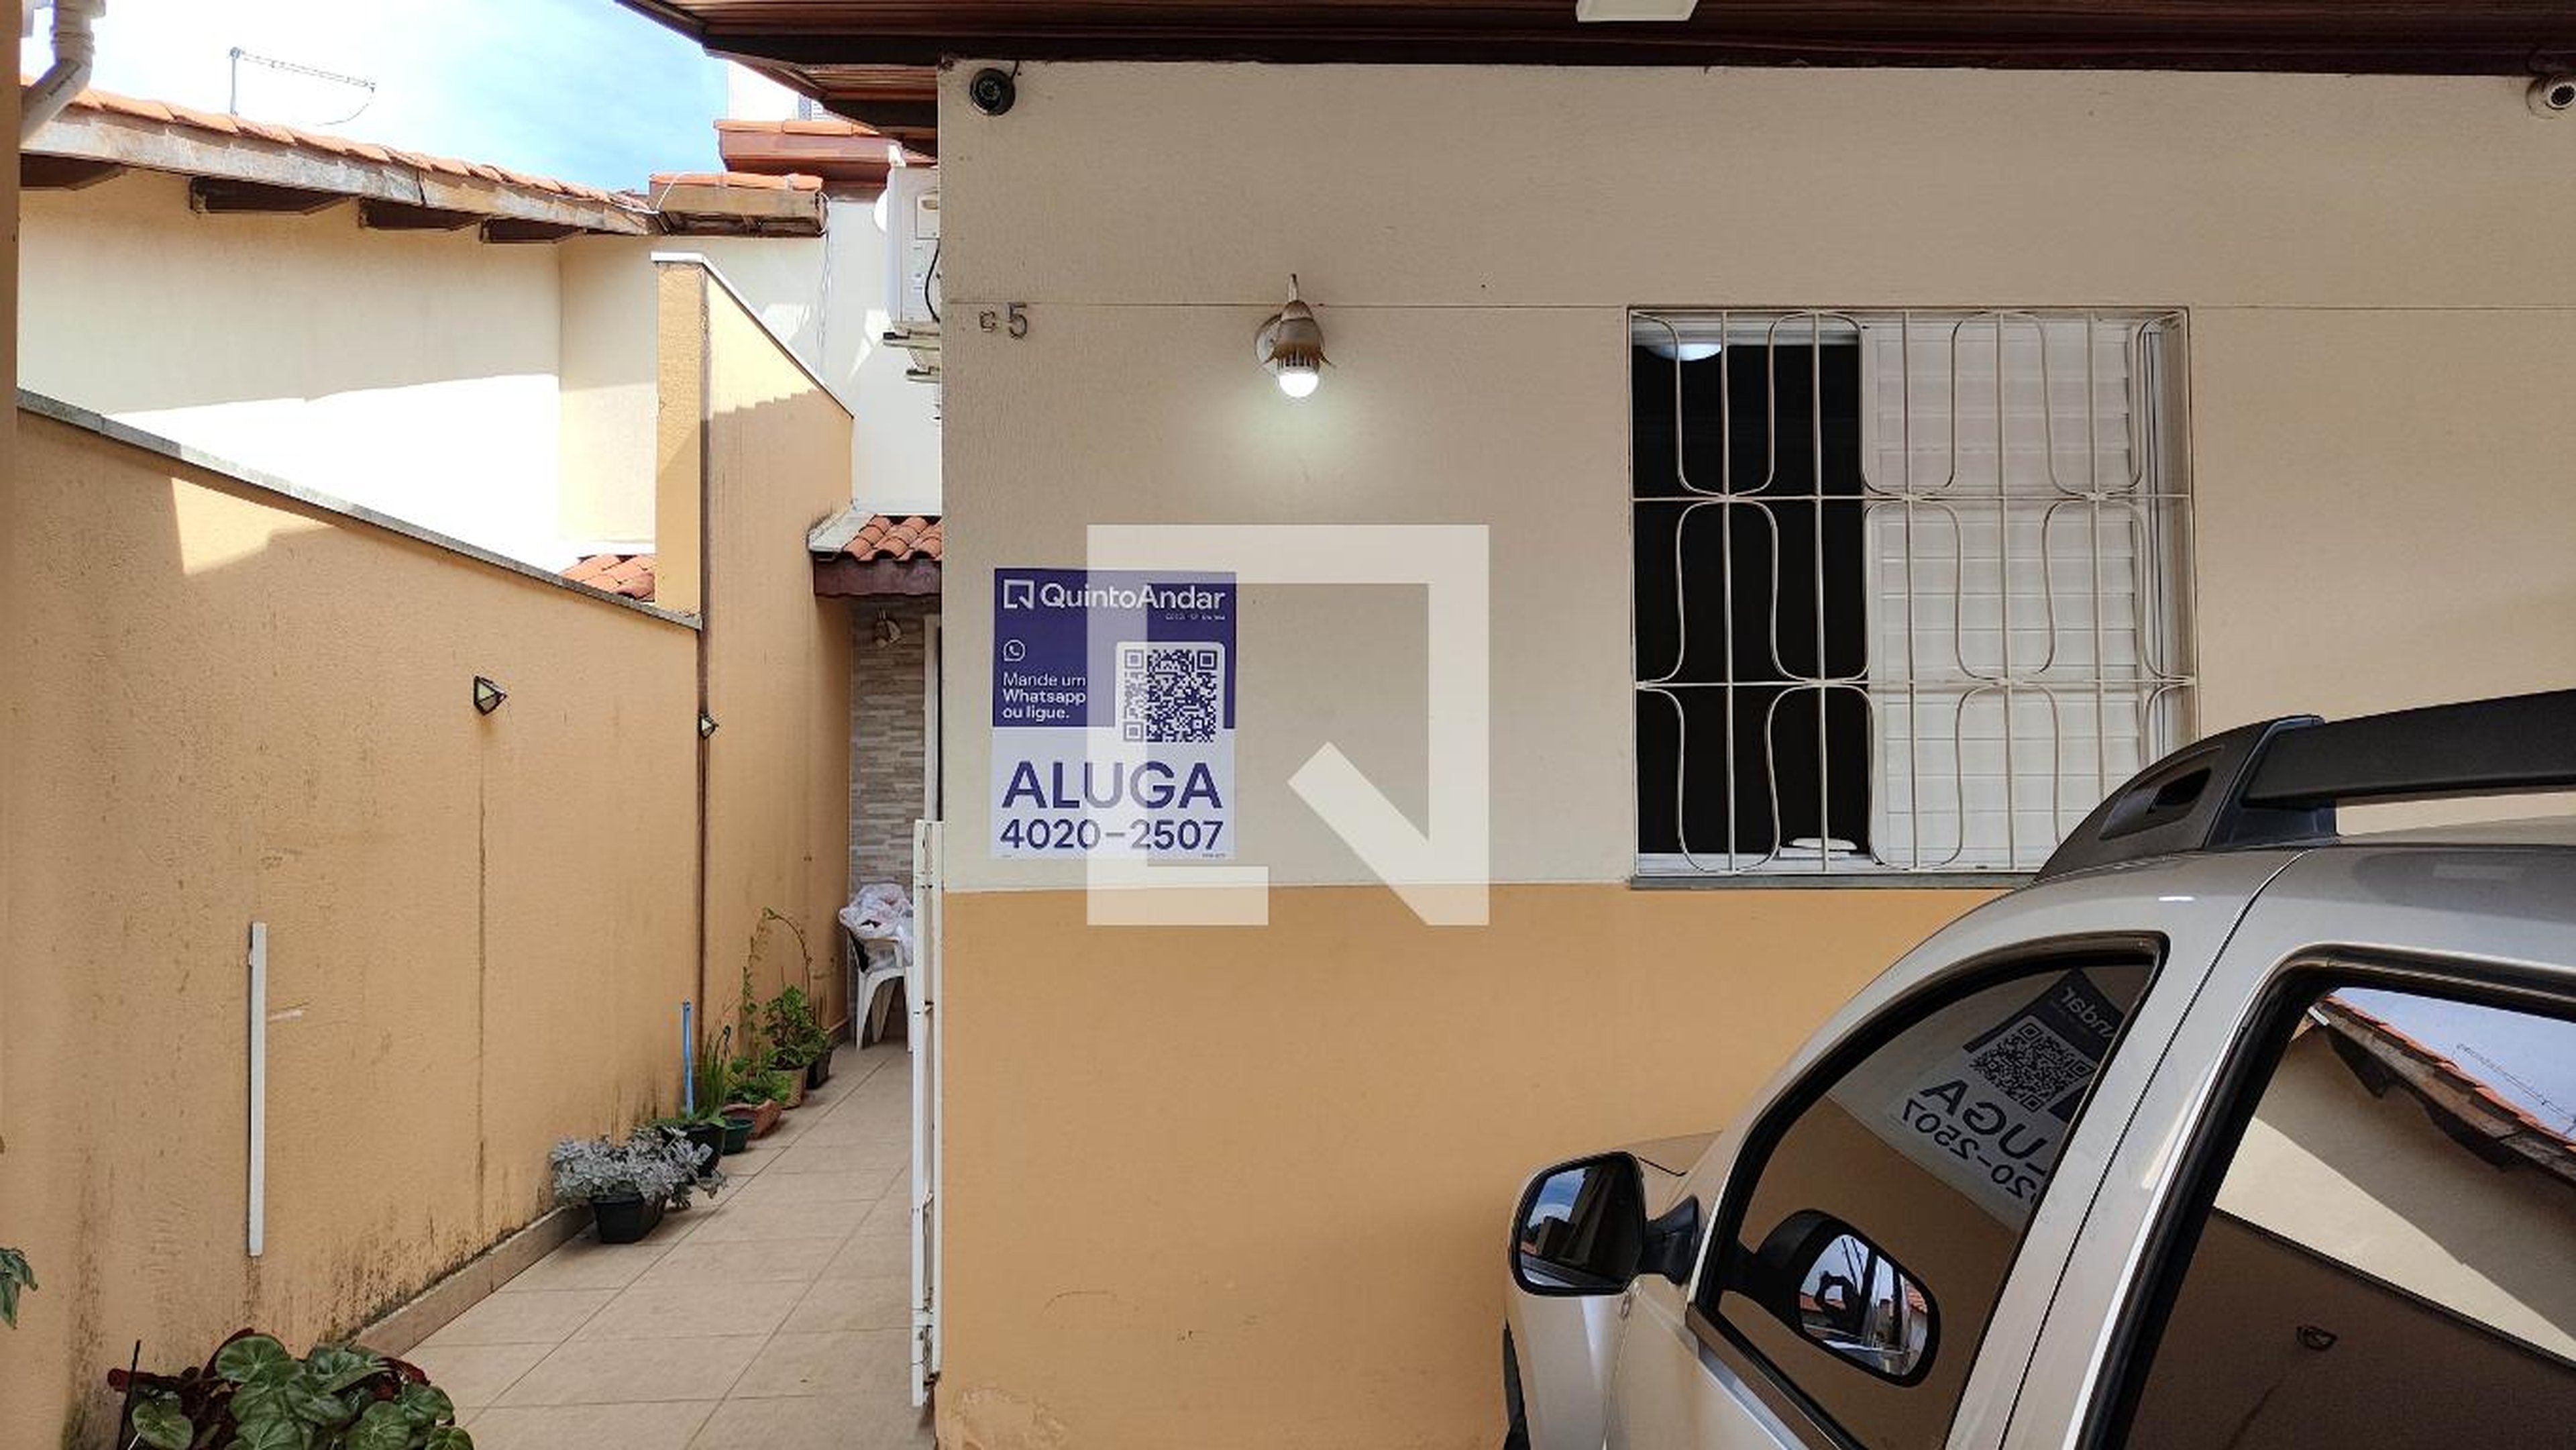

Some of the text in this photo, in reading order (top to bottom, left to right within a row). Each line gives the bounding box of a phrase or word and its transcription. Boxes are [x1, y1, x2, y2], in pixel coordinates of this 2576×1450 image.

[1041, 584, 1226, 611] QuintoAndar
[1003, 672, 1086, 686] Mande um
[1002, 688, 1086, 706] Whatsapp
[1003, 705, 1070, 722] ou ligue.
[1002, 761, 1223, 809] ALUGA
[1000, 819, 1224, 851] 4020-2507
